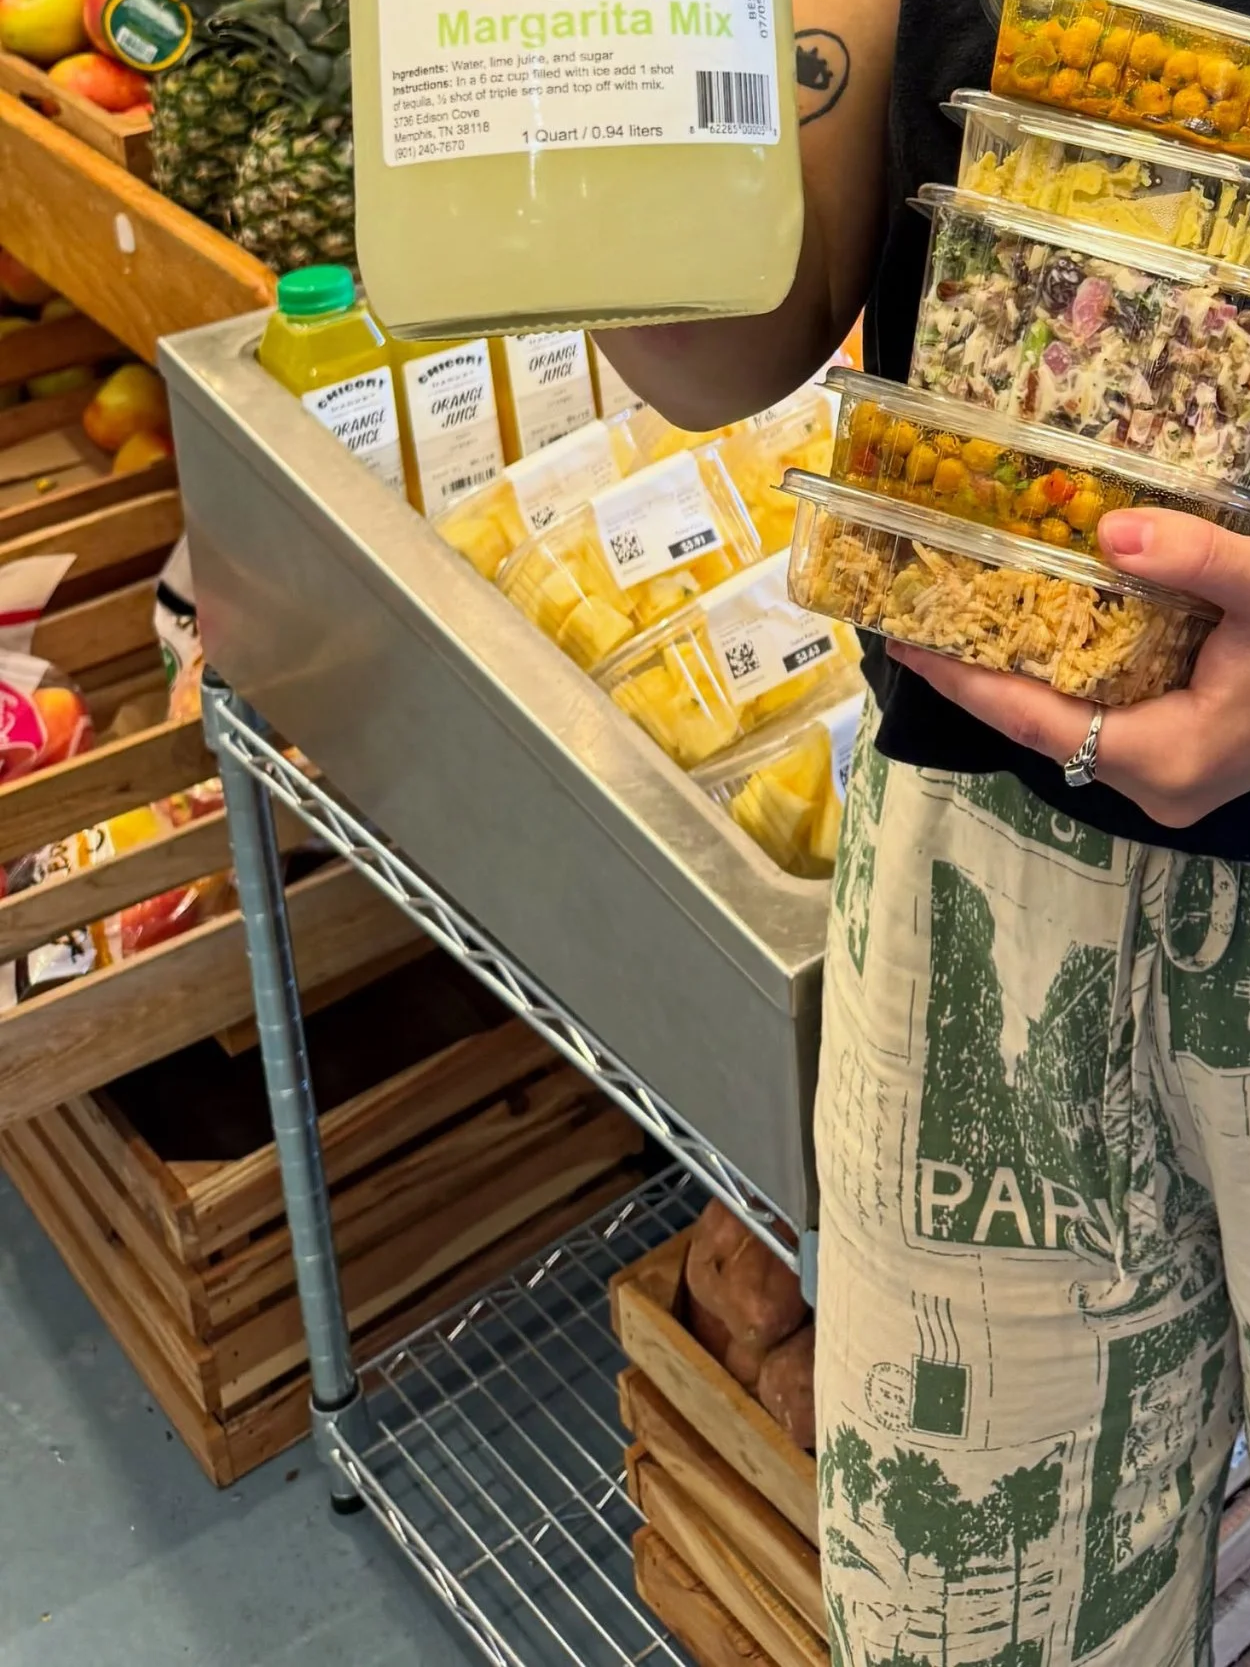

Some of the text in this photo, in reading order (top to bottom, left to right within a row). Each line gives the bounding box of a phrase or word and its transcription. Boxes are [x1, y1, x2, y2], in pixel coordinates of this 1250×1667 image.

[437, 0, 734, 49] Margarita Mix
[392, 64, 448, 82] Ingredients:
[451, 59, 486, 72] Water,
[490, 56, 514, 68] lime
[553, 52, 576, 63] and
[580, 52, 614, 63] sugar
[393, 80, 453, 96] Instructions:
[456, 76, 466, 86] In
[470, 76, 476, 86] a
[490, 74, 504, 84] oz
[507, 71, 530, 84] cup
[533, 68, 560, 80] filled
[565, 66, 590, 78] with
[594, 66, 610, 76] ice
[614, 64, 636, 76] add
[640, 64, 646, 75] 1
[650, 64, 674, 75] shot
[403, 97, 435, 110] tequila,
[450, 91, 473, 104] shot
[476, 89, 486, 100] of
[490, 88, 518, 99] triple
[546, 83, 569, 94] and
[573, 83, 592, 95] top
[596, 80, 612, 92] off
[614, 80, 638, 91] with
[641, 80, 665, 91] mix.
[416, 112, 449, 125] Edison
[451, 108, 480, 120] Cove
[394, 121, 490, 143] Memphis, TN 38118
[523, 124, 664, 144] 1 Quart / 0.94 liters
[418, 139, 466, 156] 240-7670
[417, 353, 486, 385] CHICORY
[528, 343, 579, 372] ORANGE
[538, 364, 574, 386] JUICE
[317, 376, 386, 410] CHICORY
[431, 386, 484, 416] ORANGE
[332, 408, 386, 439] ORANGE
[441, 404, 480, 430] JUICE
